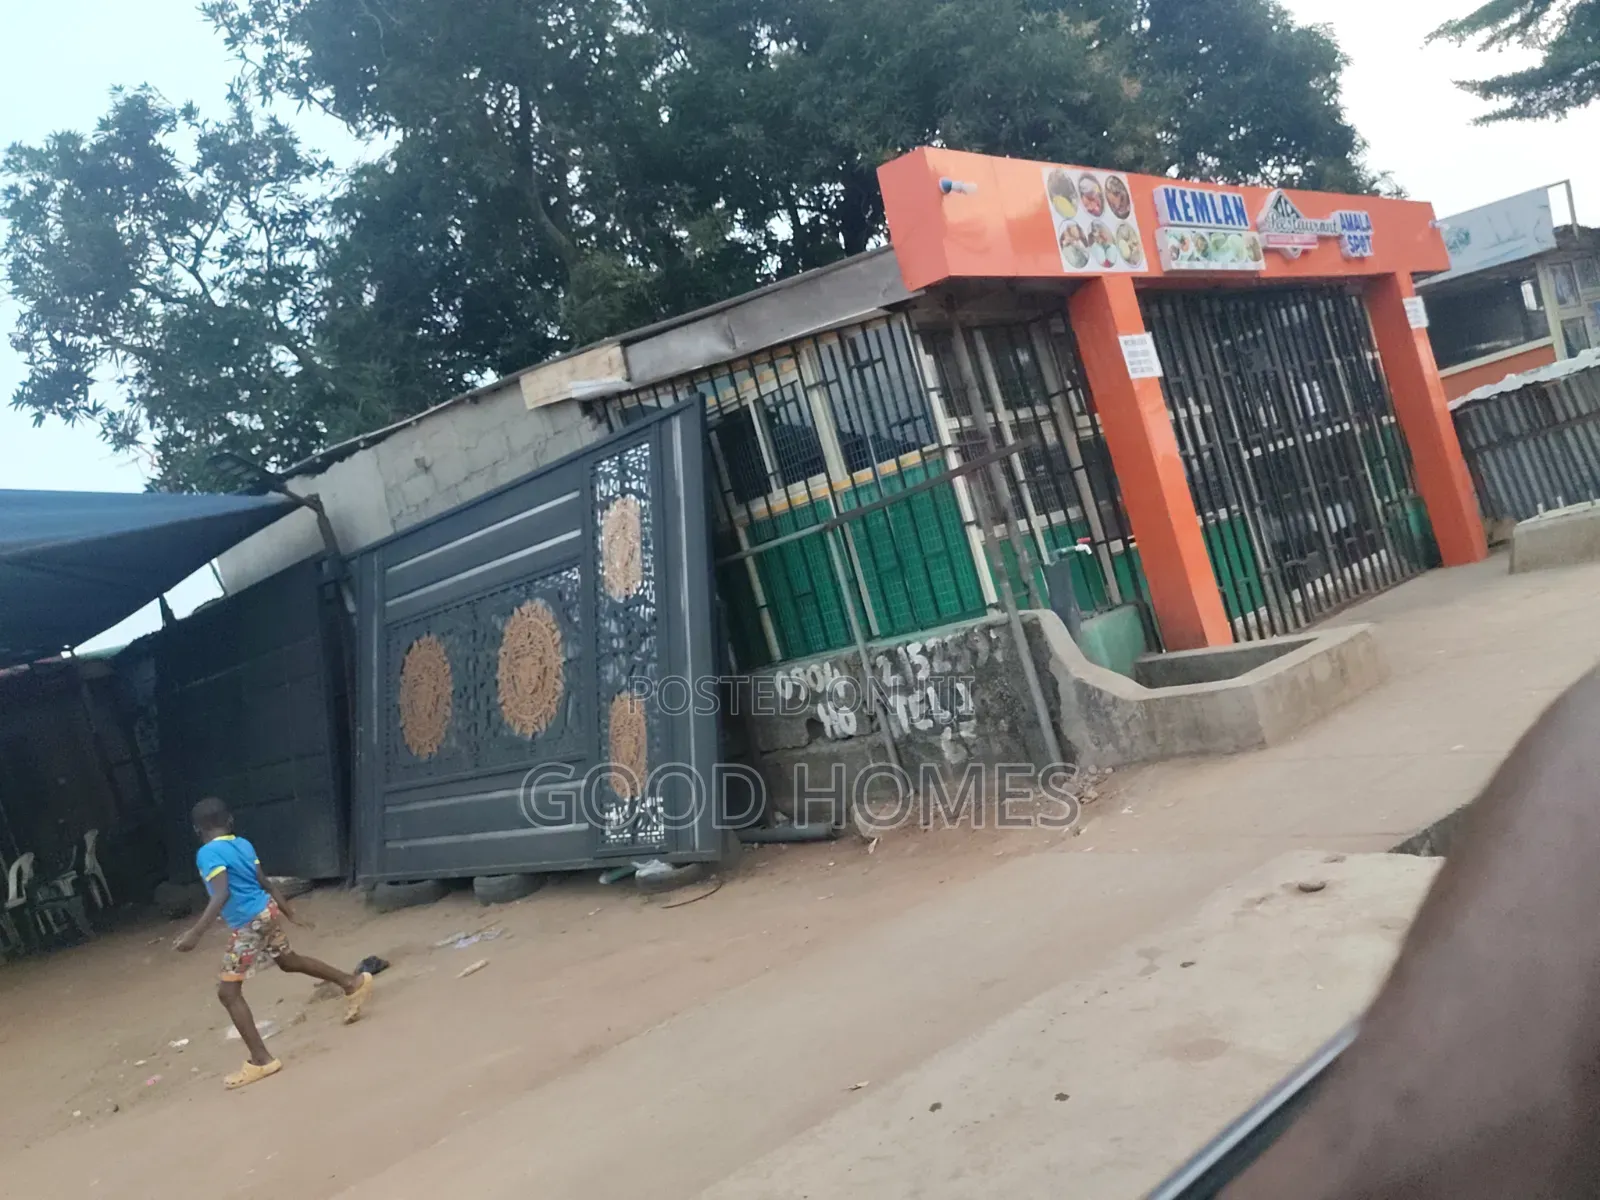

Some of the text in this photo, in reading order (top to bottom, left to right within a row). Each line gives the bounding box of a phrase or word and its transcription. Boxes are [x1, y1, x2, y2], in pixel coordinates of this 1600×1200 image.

[1163, 187, 1249, 227] KEMLAN
[1265, 211, 1338, 234] Restaurant
[1339, 212, 1373, 232] AMALA
[1346, 234, 1373, 254] SPOT
